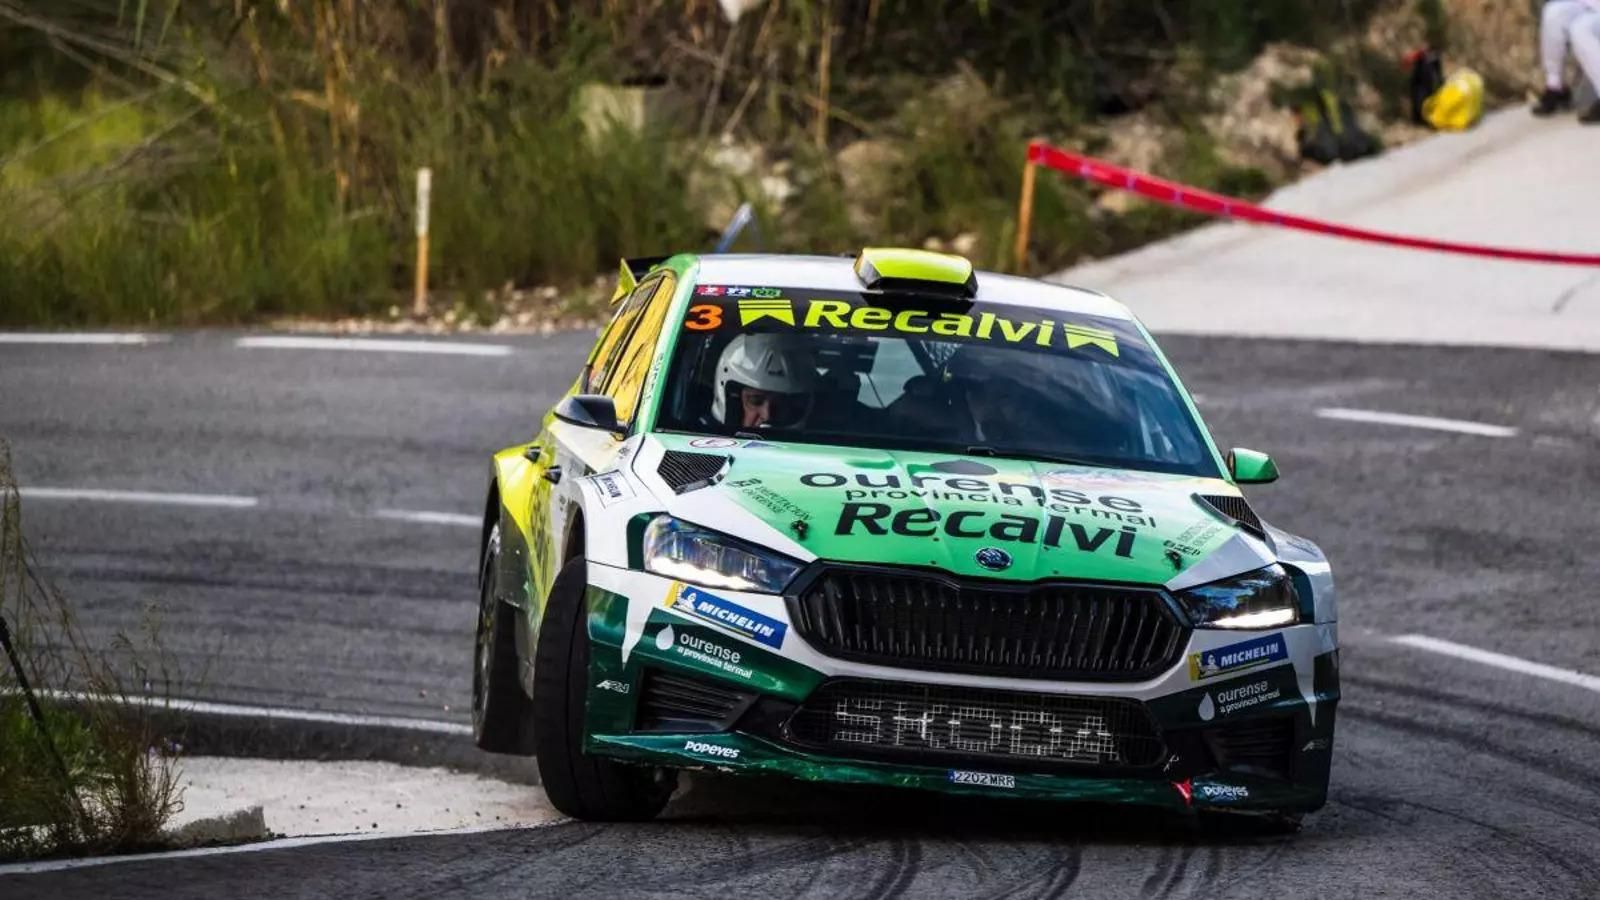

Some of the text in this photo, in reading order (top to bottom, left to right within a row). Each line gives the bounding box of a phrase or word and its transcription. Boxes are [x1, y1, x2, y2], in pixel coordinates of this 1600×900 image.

[685, 304, 723, 330] 3
[803, 300, 1055, 346] Recalvi
[800, 473, 1143, 512] ourense
[845, 489, 1156, 528] provincia termal
[834, 502, 1136, 560] Recalvi
[697, 601, 775, 637] MICHELIN
[680, 633, 741, 663] ourense
[683, 649, 722, 668] provincia
[723, 661, 752, 679] termal
[1221, 642, 1279, 667] MICHELIN
[1217, 680, 1269, 704] ourense
